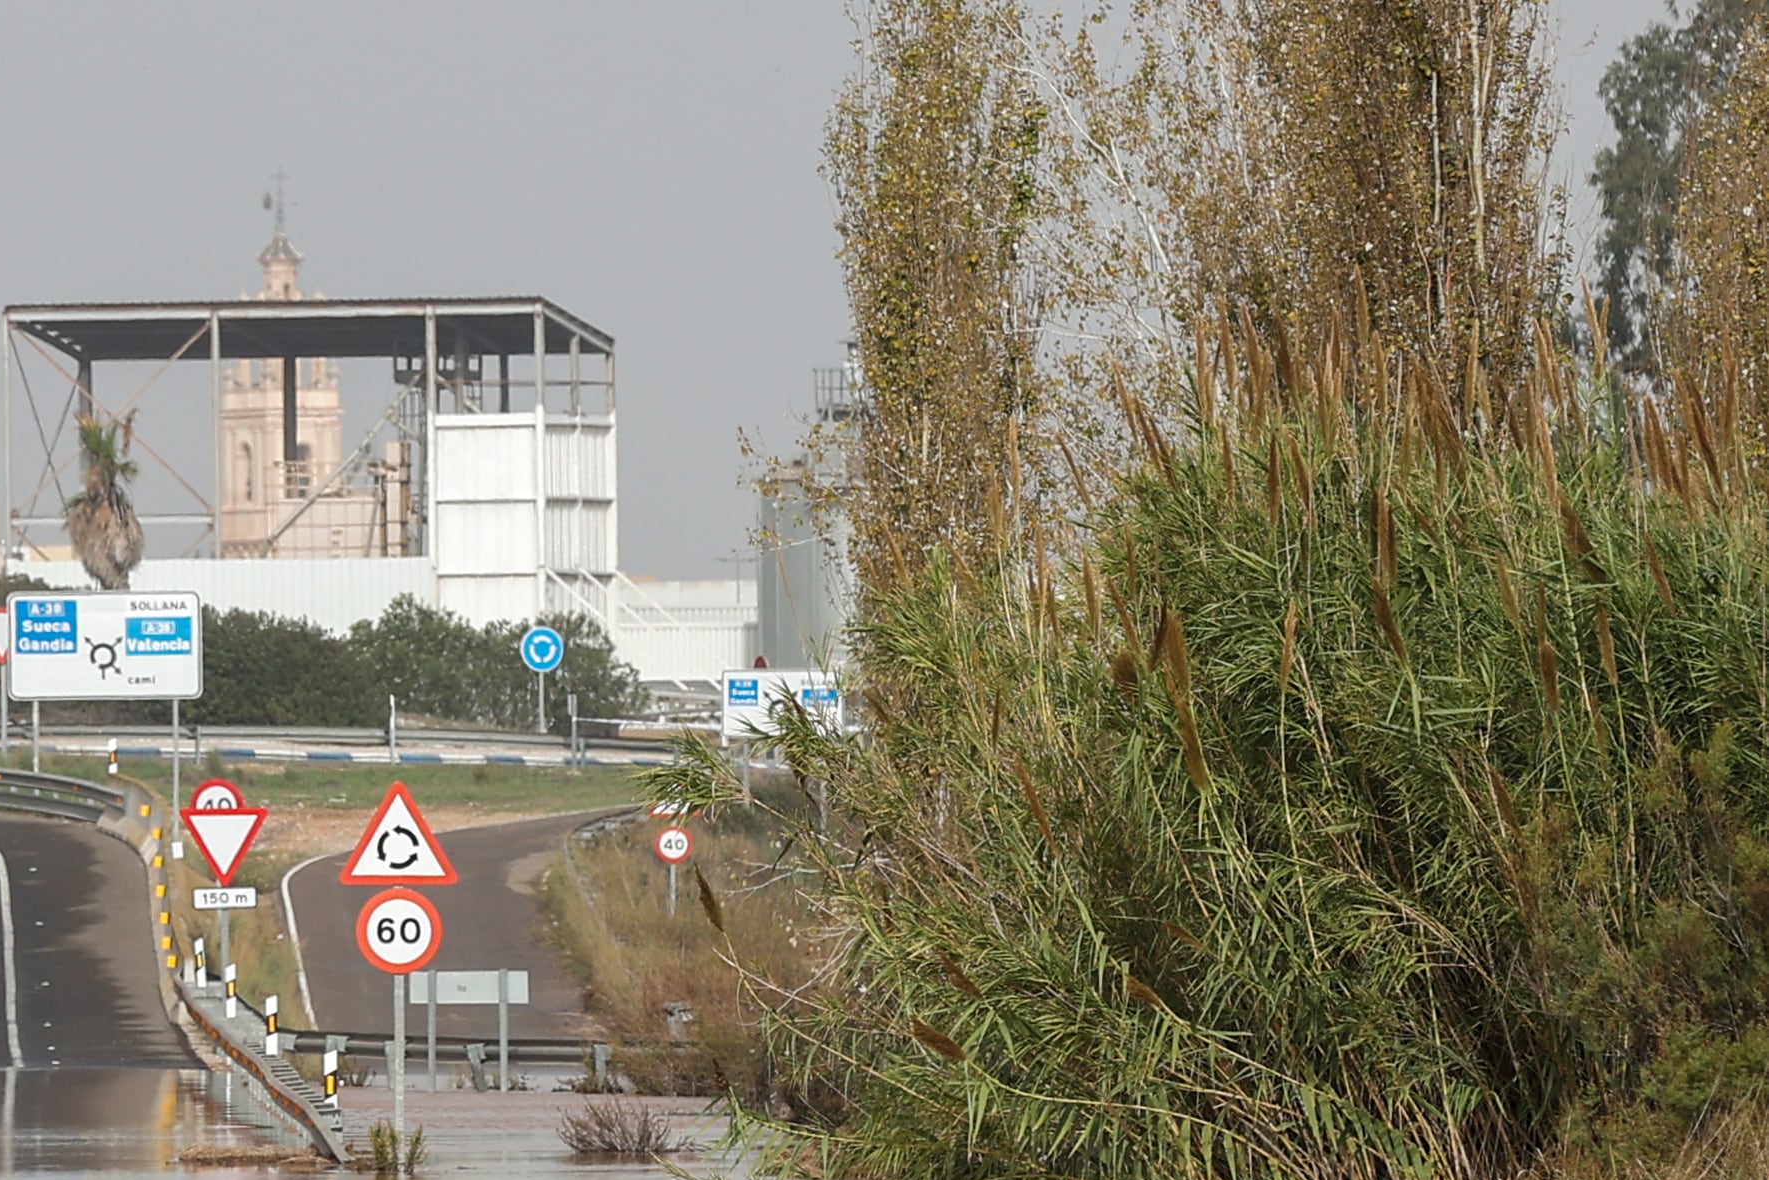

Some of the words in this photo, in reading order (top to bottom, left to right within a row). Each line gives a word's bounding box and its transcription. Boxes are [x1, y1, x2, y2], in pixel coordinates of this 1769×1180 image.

[129, 601, 187, 611] SOLLANA
[22, 619, 71, 633] Sueca
[18, 637, 74, 651] Gandia
[126, 637, 191, 652] Valencia
[663, 836, 685, 850] 40
[202, 891, 230, 905] 150
[235, 894, 248, 904] m
[376, 918, 421, 944] 60
